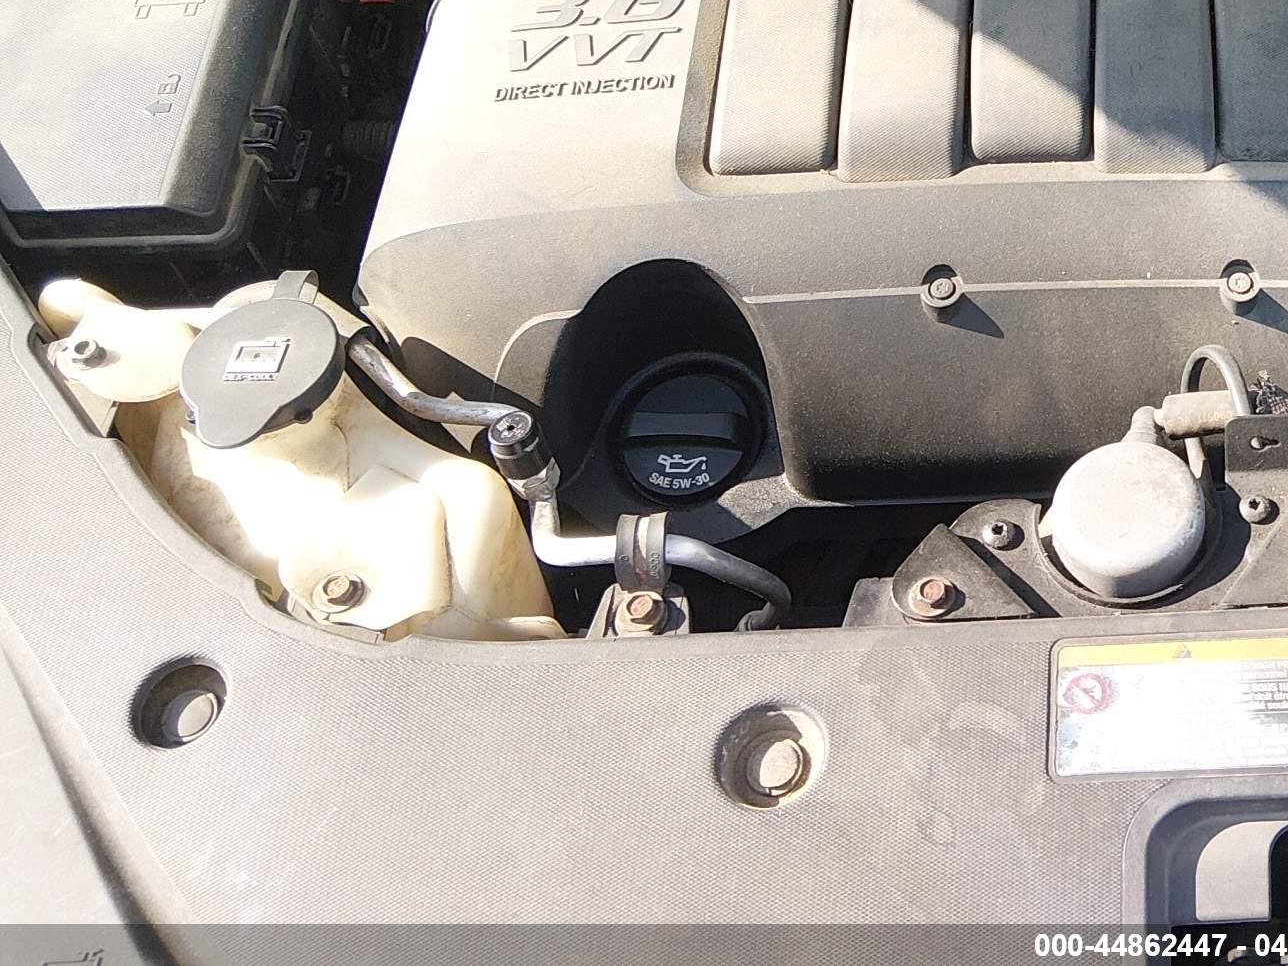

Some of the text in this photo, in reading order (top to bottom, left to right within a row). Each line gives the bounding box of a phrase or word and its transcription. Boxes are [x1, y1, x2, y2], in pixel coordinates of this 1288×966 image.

[508, 27, 683, 73] VVT
[494, 74, 676, 102] DIRECT INJECTION
[648, 472, 710, 489] SAE 5W-30
